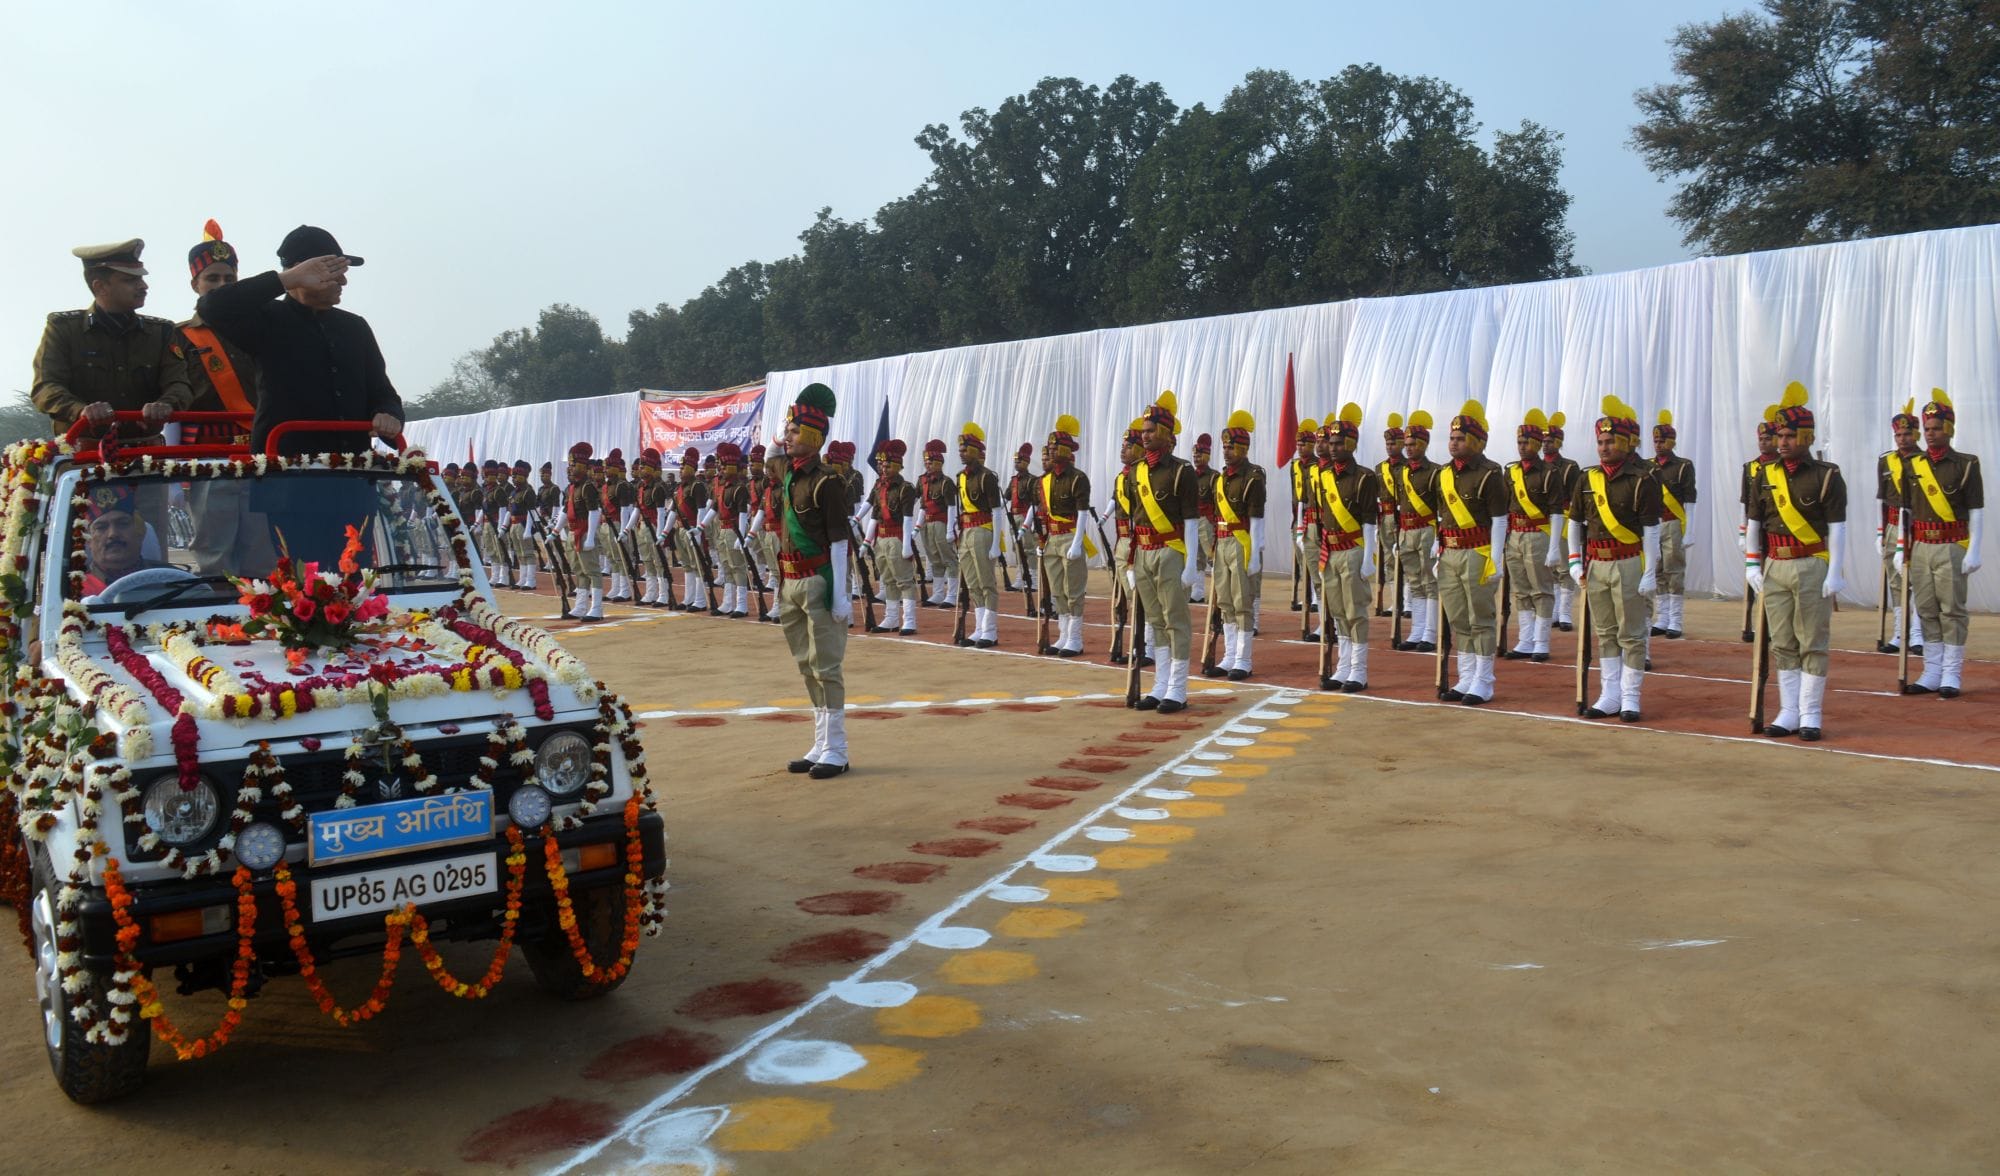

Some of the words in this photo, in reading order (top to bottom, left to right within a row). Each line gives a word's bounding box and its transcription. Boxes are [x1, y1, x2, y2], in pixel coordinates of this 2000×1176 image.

[677, 405, 694, 420] परेड
[696, 404, 724, 419] समारोह
[726, 399, 741, 414] वर्ष
[678, 427, 702, 446] पुलिस
[730, 425, 750, 443] मथुरा
[318, 815, 386, 852] मुख्य
[395, 795, 485, 834] अतिथि
[323, 880, 385, 911] UP85
[392, 874, 426, 901] AG
[433, 864, 486, 893] 0295
